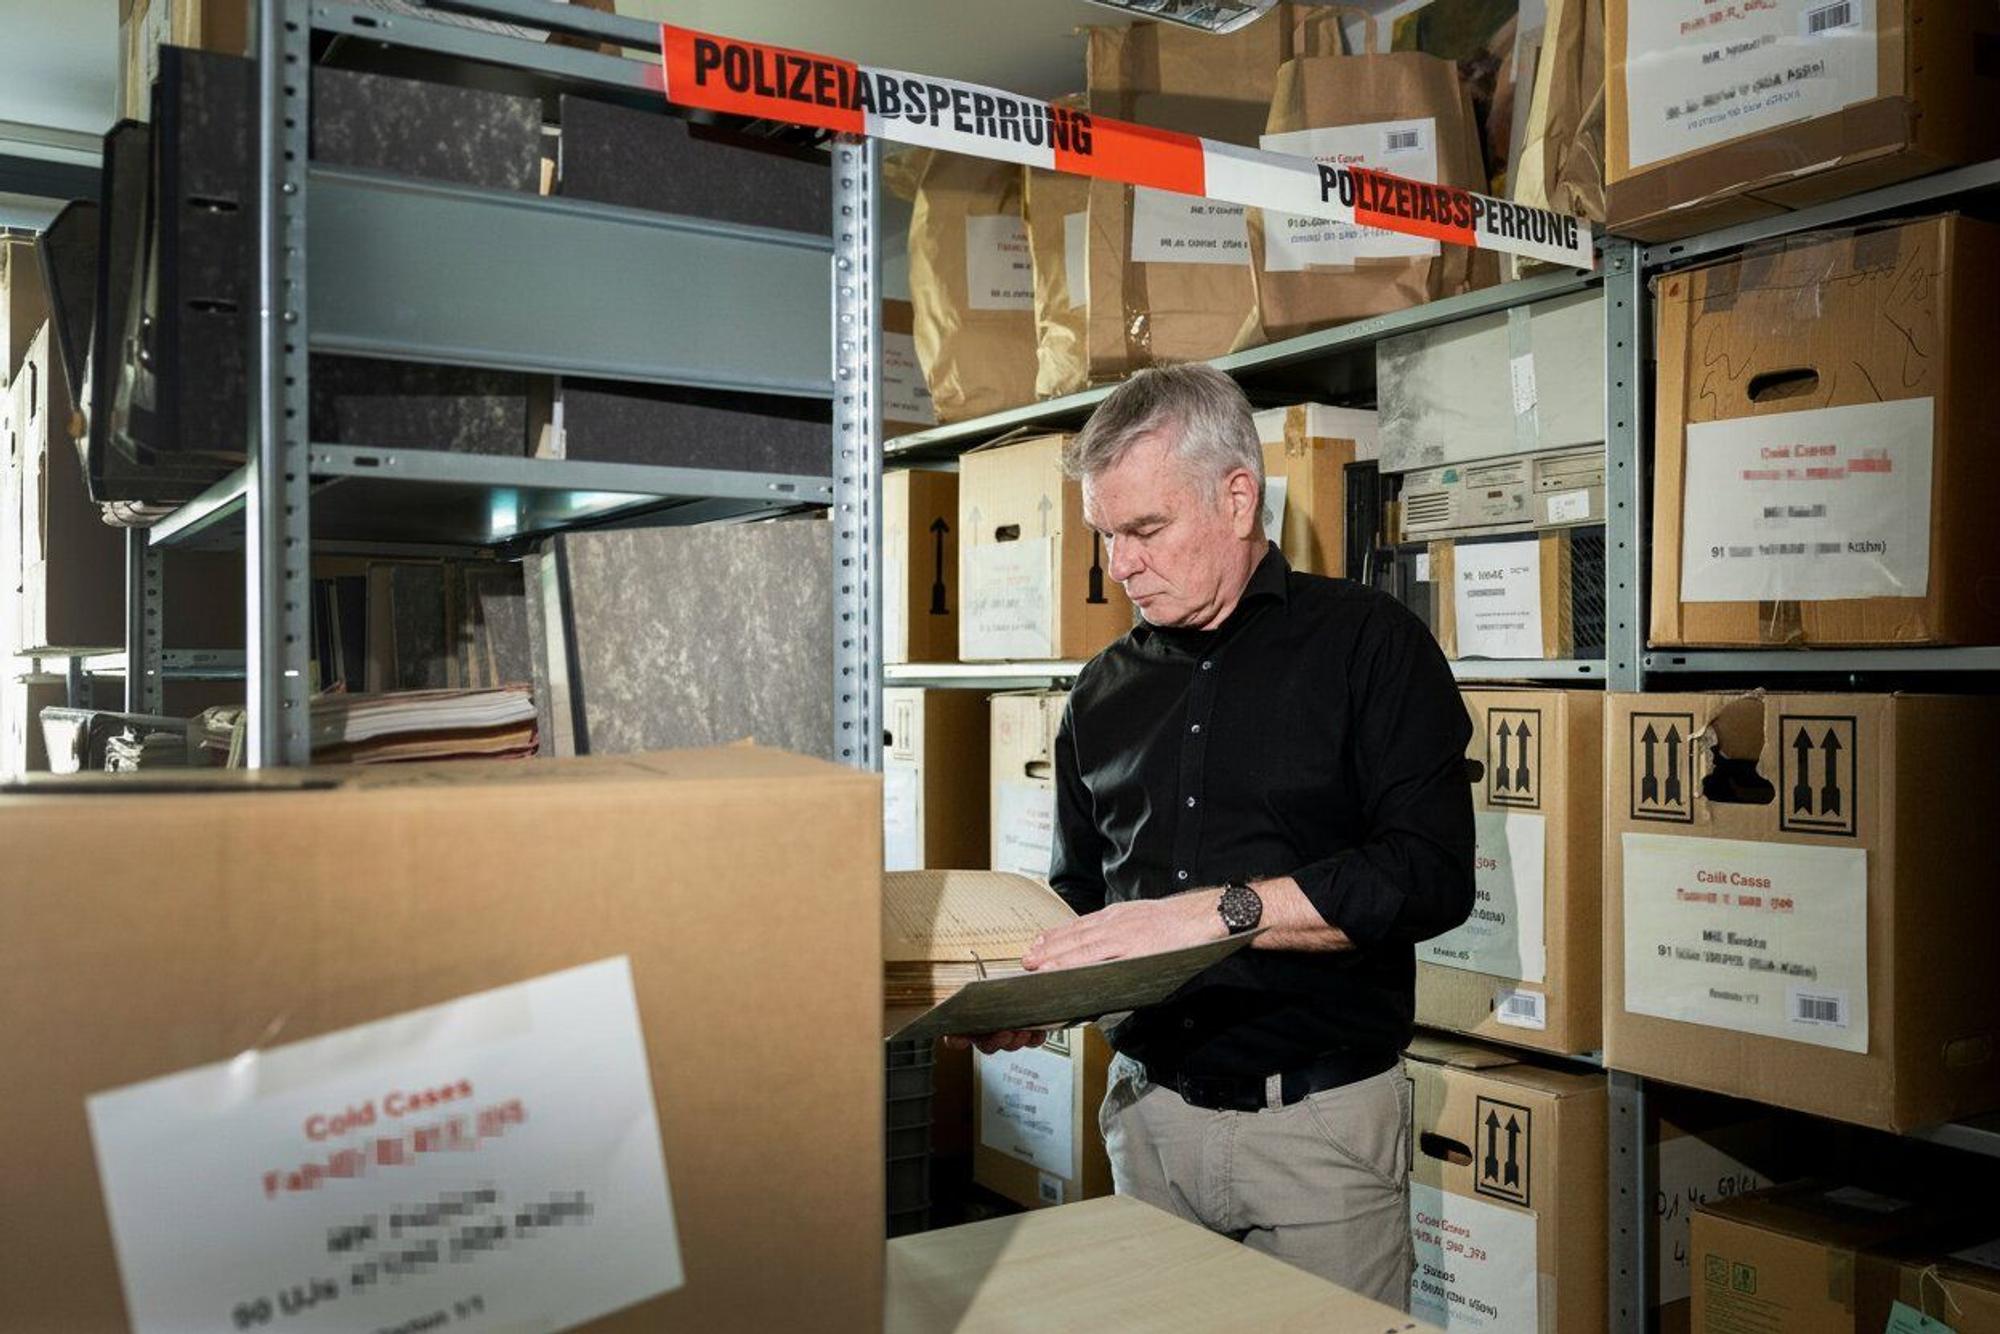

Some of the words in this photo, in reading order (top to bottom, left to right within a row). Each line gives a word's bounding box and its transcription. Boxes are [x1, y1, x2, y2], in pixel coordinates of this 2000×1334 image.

[694, 38, 1093, 156] POLIZEIABSPERRUNG
[1317, 164, 1578, 250] POLIZEIABSPERRUNG
[305, 1101, 377, 1141] Cold
[382, 1078, 474, 1118] Cases
